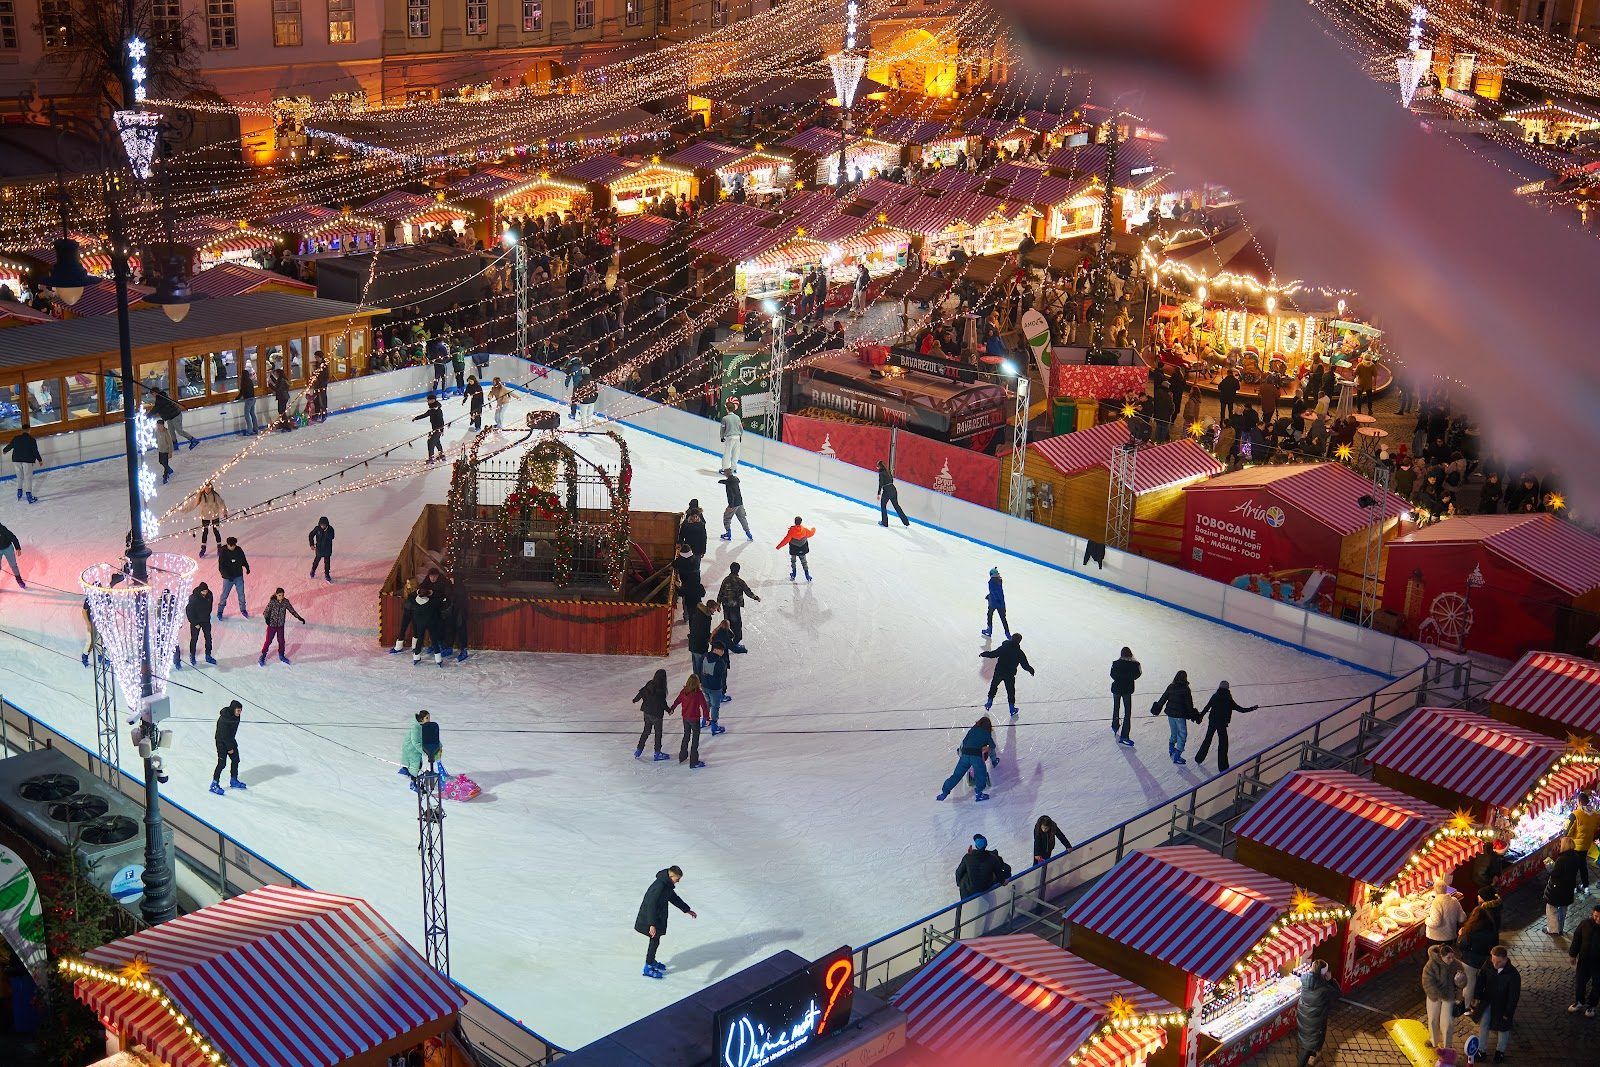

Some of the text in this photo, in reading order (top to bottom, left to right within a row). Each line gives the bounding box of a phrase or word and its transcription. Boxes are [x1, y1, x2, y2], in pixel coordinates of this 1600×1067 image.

[900, 354, 938, 374] BAVAREZUL
[1229, 499, 1267, 524] Aria
[1195, 525, 1219, 538] Bazine
[1219, 533, 1243, 545] pentru
[1196, 513, 1257, 540] TOBOGANE
[1194, 534, 1206, 544] SPA
[1210, 539, 1237, 553] MASAJE
[1241, 548, 1261, 560] FOOD
